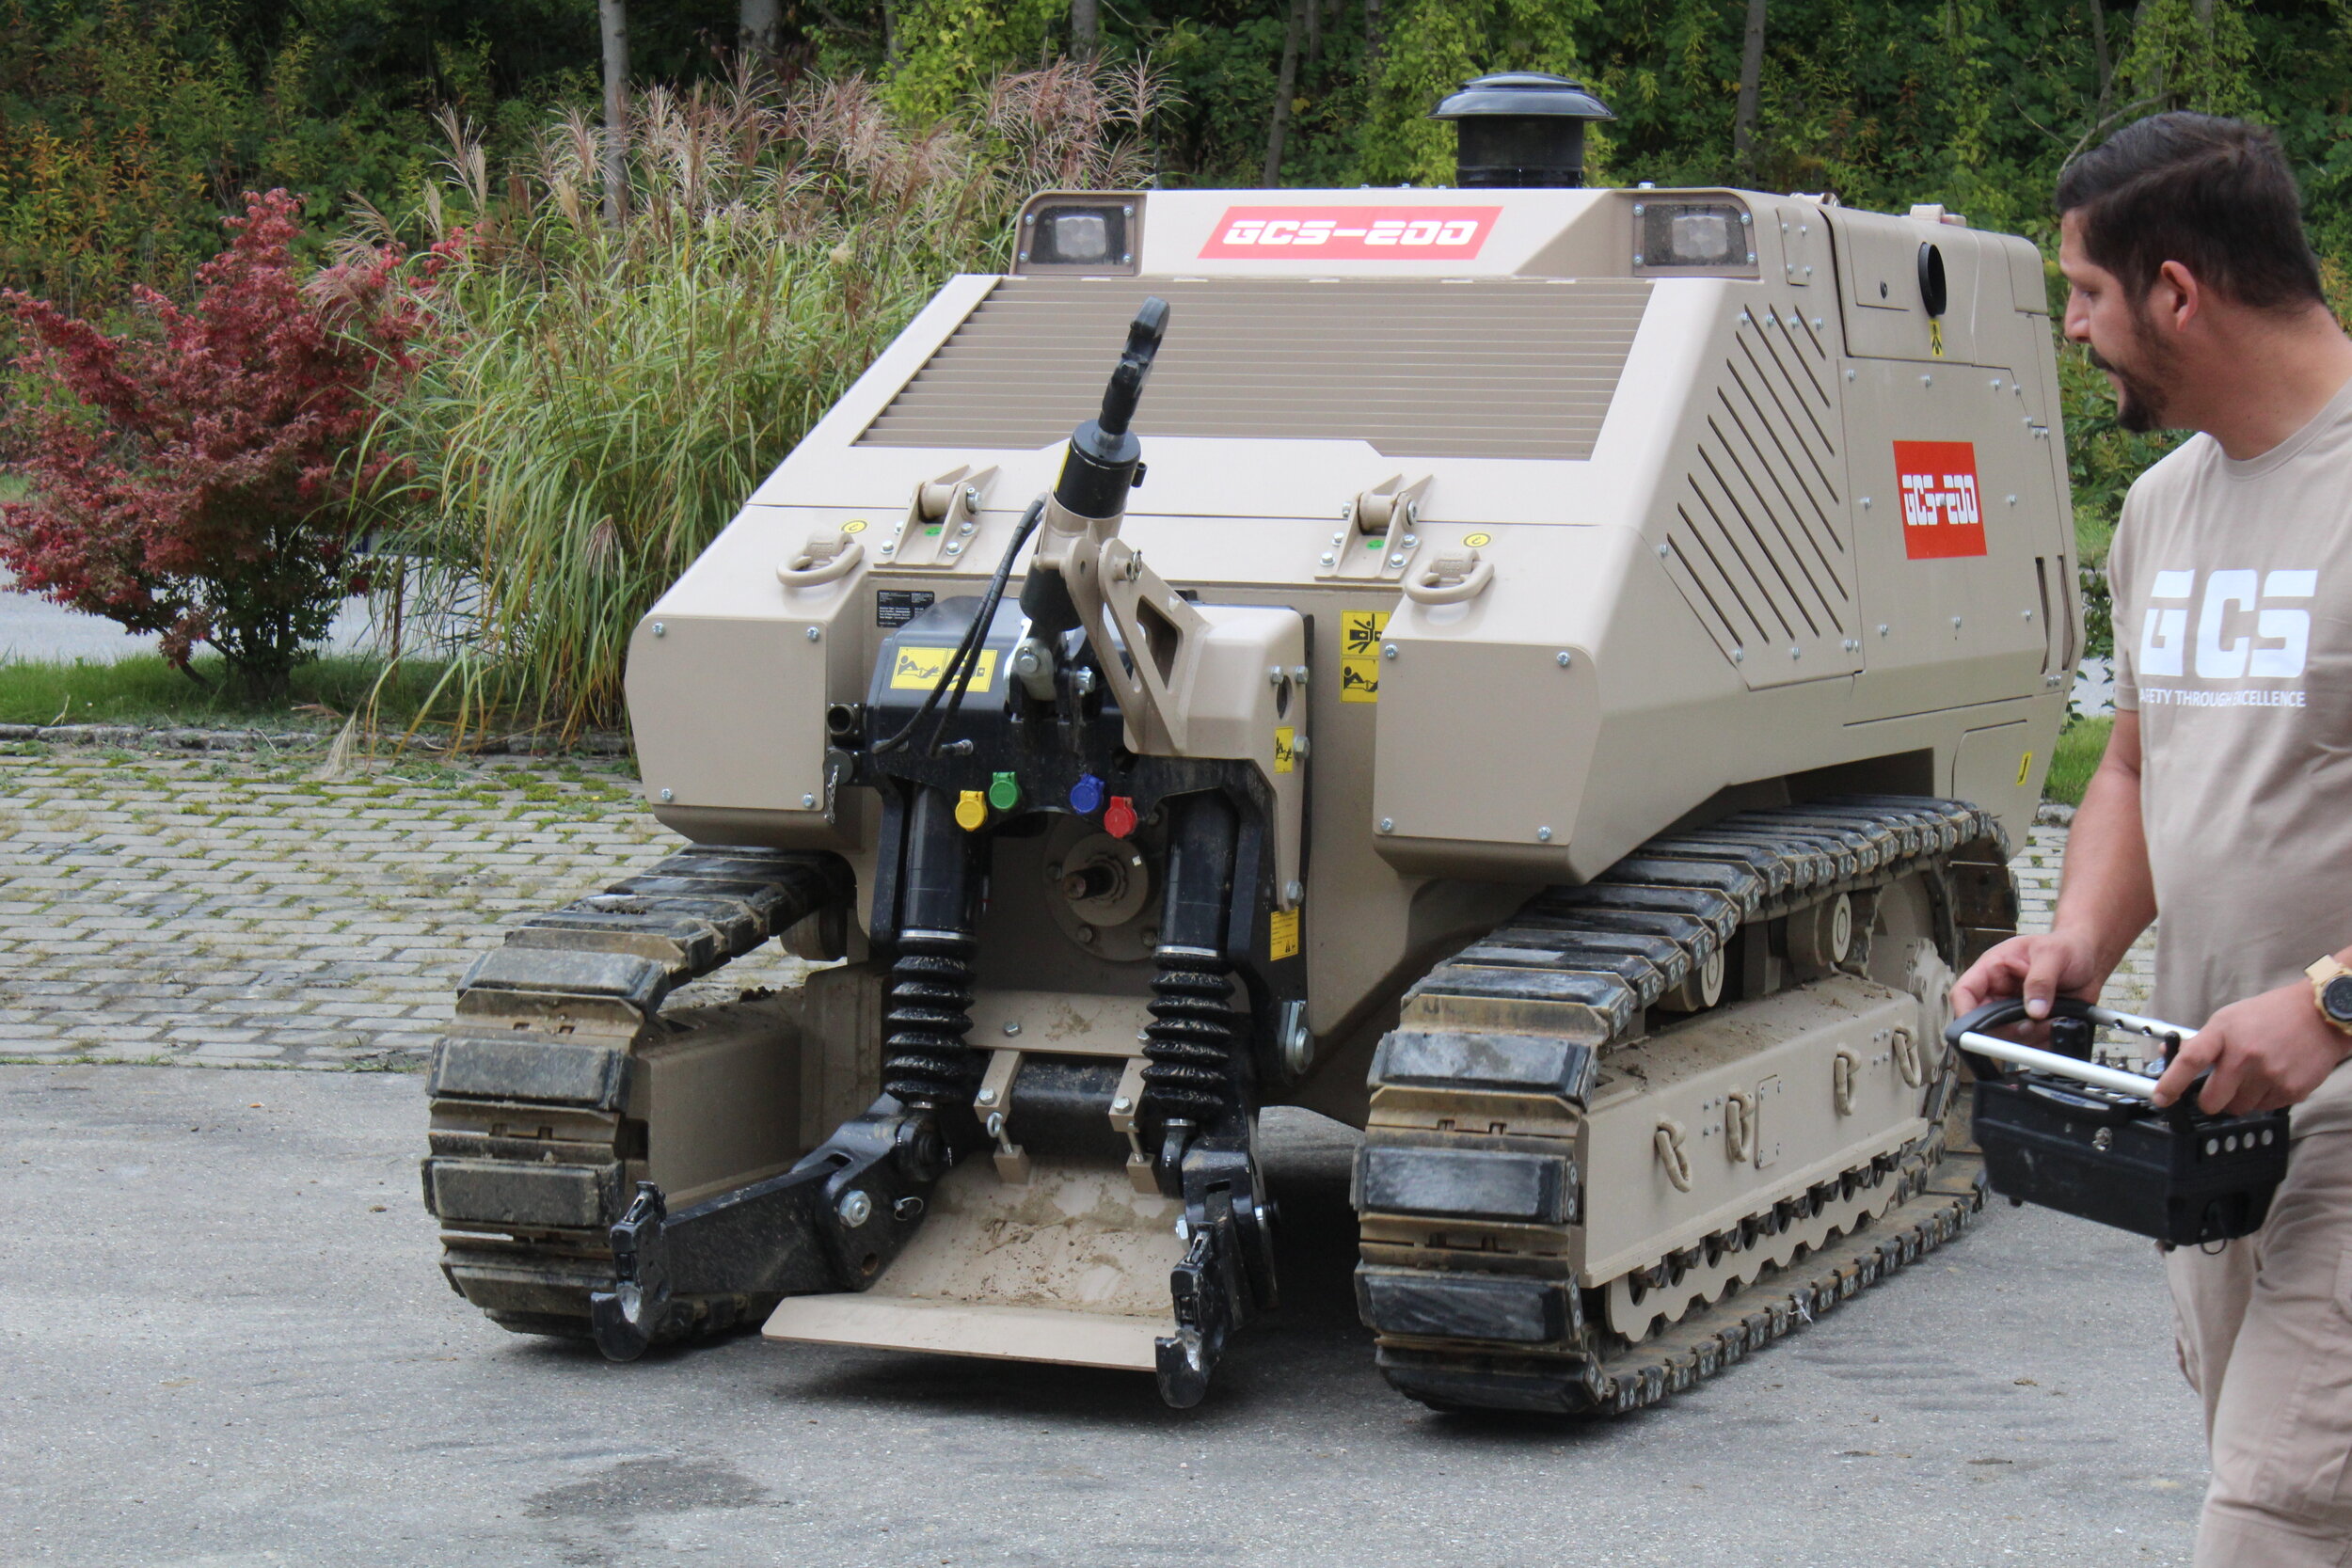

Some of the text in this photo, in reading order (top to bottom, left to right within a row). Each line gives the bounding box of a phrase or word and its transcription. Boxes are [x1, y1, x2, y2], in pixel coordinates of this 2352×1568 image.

[1223, 220, 1479, 245] GCS-200
[1901, 474, 1979, 526] GCS-200
[2139, 569, 2318, 678] GCS
[2138, 688, 2172, 705] AFETY
[2175, 689, 2232, 707] THROUGH
